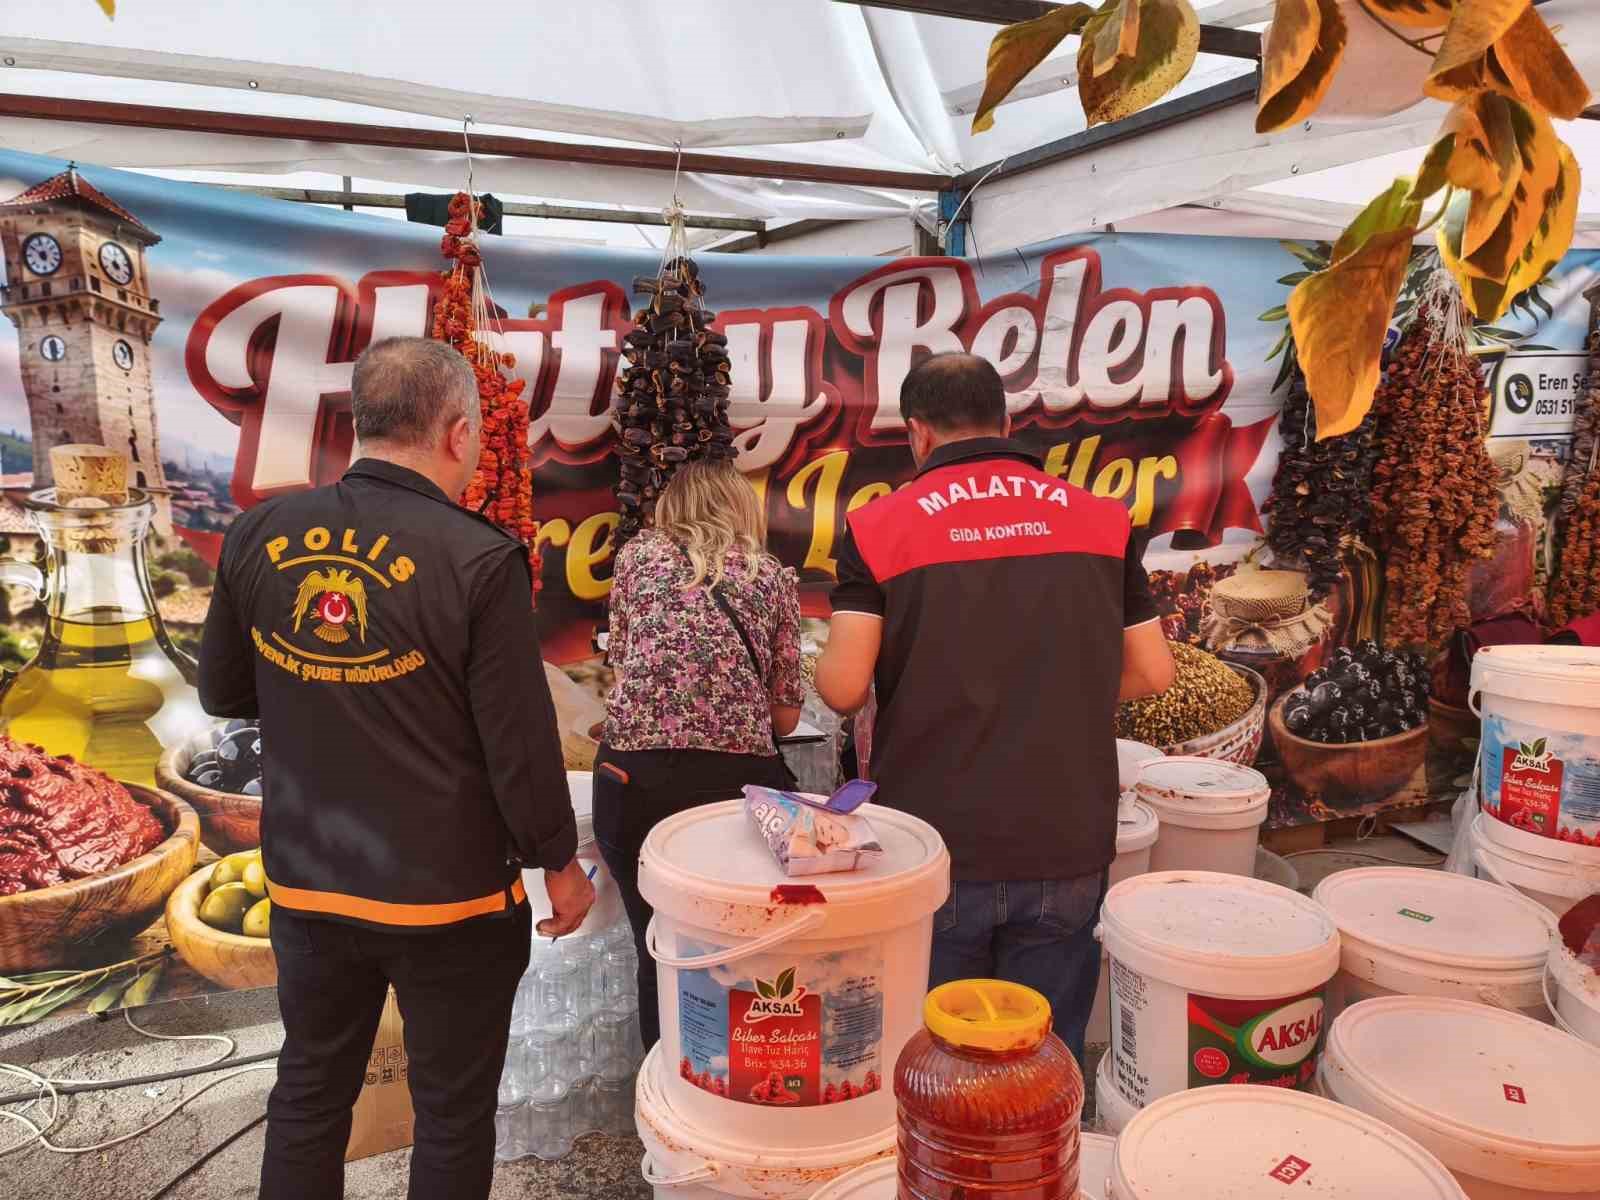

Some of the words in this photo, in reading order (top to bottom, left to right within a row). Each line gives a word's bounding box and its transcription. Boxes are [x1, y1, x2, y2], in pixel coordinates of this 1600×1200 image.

[203, 282, 829, 491] Hty
[840, 256, 1226, 430] Belen
[1538, 373, 1568, 390] Eren
[1535, 400, 1558, 415] 0531
[917, 475, 1069, 516] MALATYA
[950, 528, 982, 542] GIDA
[985, 521, 1052, 541] KONTROL
[302, 663, 343, 681] ŞUBE
[1516, 756, 1548, 771] AKSAL
[754, 802, 785, 834] alo
[751, 1001, 801, 1014] AKSAL
[731, 1026, 765, 1043] Biber
[768, 1027, 818, 1045] Salçası
